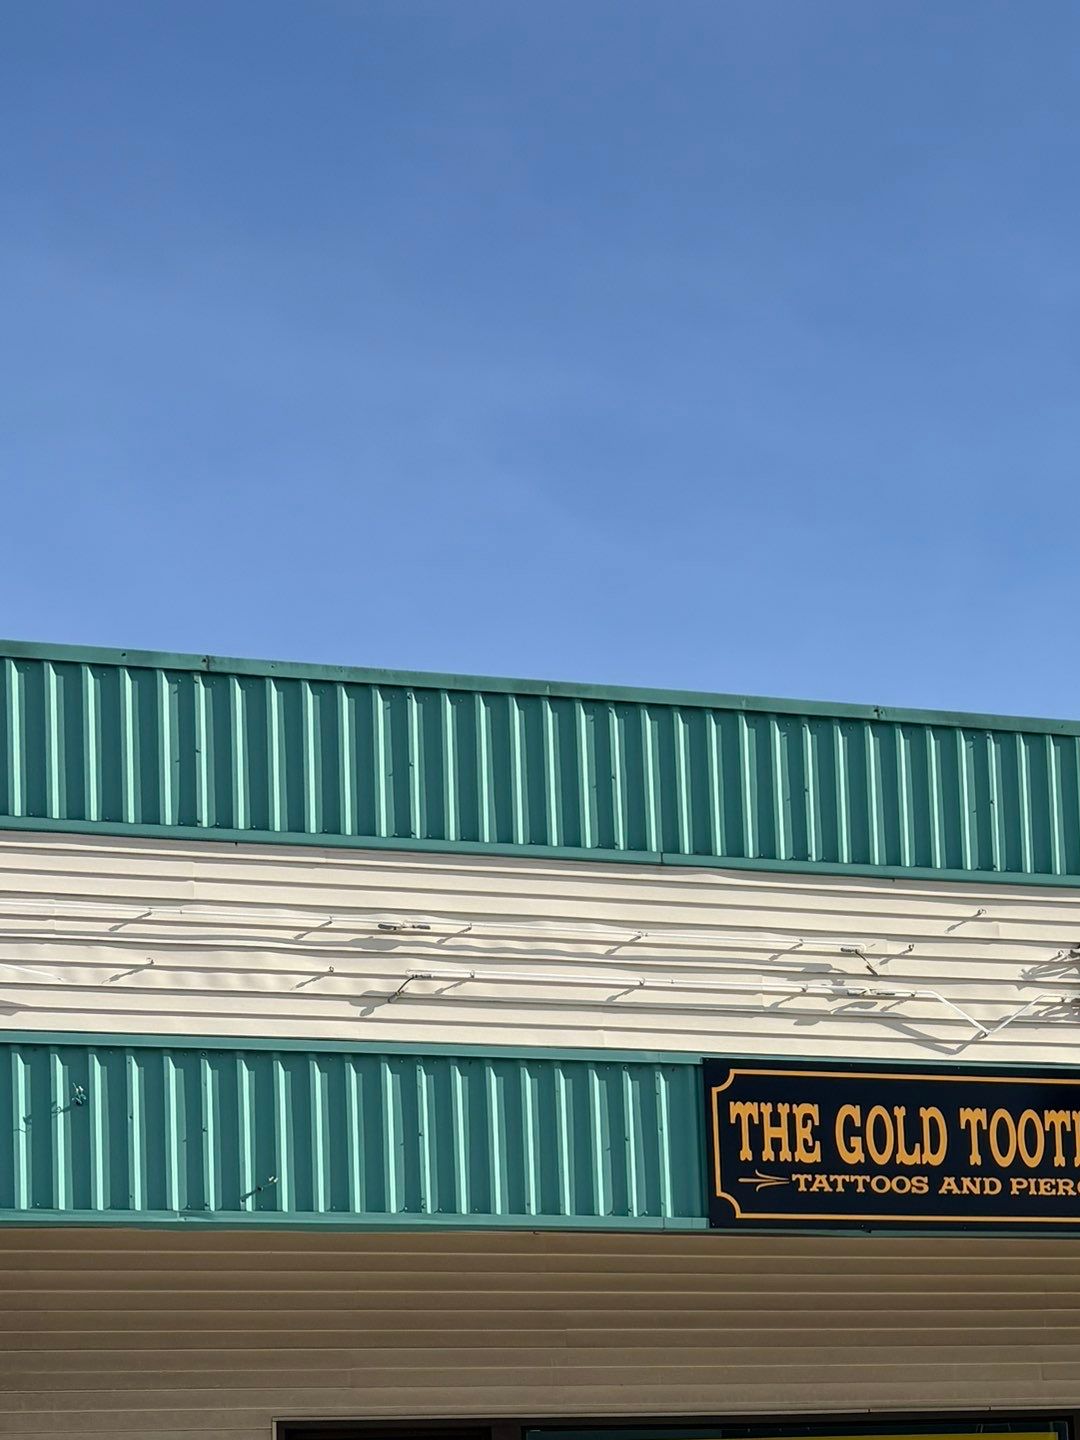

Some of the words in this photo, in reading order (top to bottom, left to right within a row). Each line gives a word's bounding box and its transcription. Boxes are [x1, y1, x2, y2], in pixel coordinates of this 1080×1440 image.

[729, 1101, 821, 1162] THE
[835, 1104, 948, 1166] GOLD
[792, 1173, 929, 1194] TATTOOS
[938, 1176, 1001, 1195] AND
